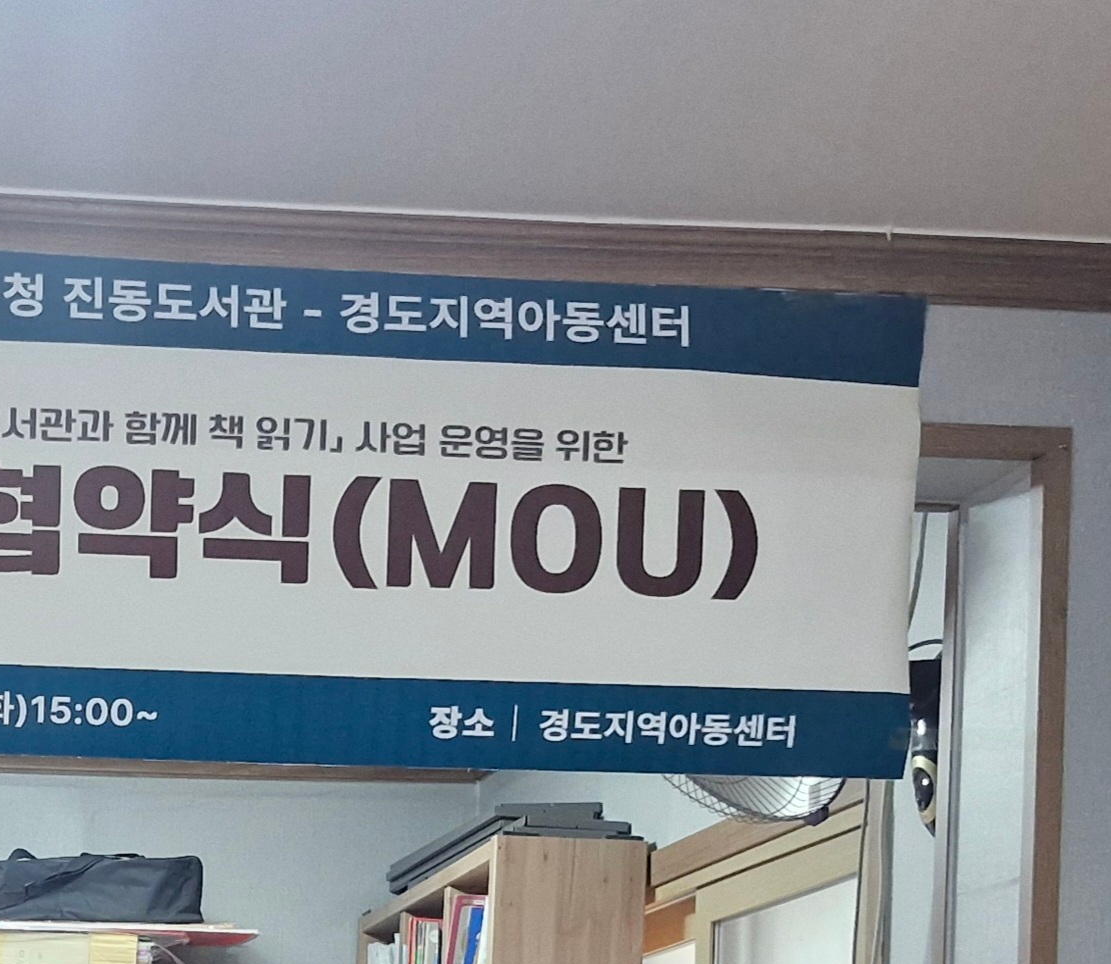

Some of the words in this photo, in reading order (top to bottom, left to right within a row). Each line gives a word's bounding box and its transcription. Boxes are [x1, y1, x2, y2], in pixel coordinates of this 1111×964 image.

[63, 275, 286, 331] 진동도서관
[340, 291, 692, 347] 경도지역아동센터
[125, 411, 197, 446] 함께
[210, 416, 245, 452] 책
[256, 418, 343, 454] 읽기」
[356, 420, 427, 457] 사업
[438, 424, 546, 463] 운영을
[556, 428, 629, 465] 위한
[428, 705, 496, 741] 장소
[539, 708, 797, 748] 경도지역아동센터
